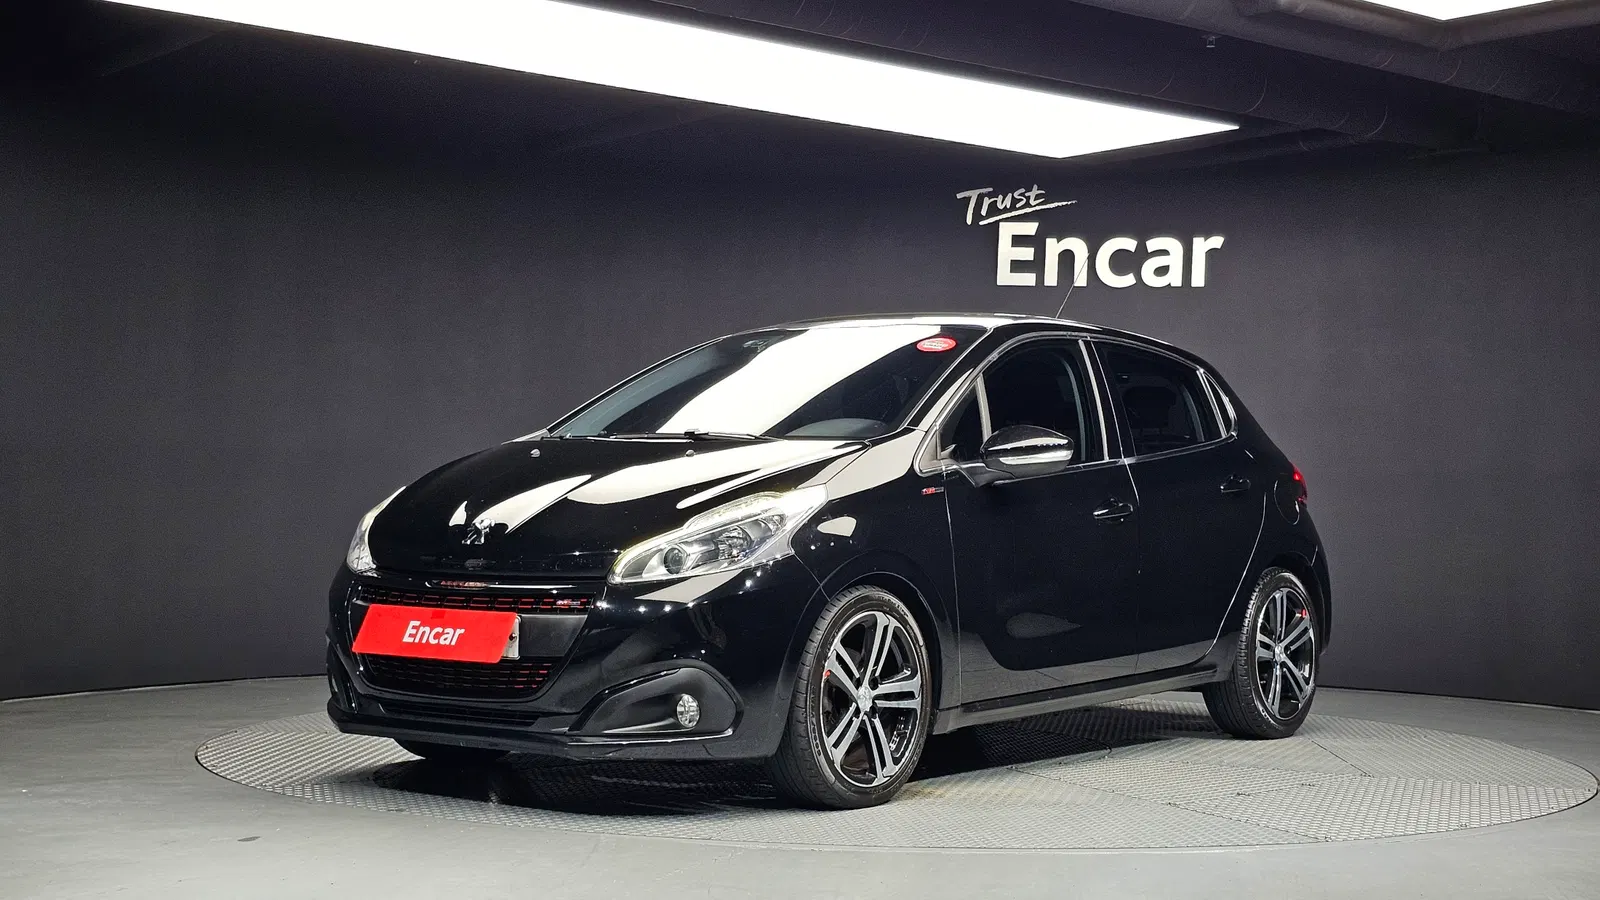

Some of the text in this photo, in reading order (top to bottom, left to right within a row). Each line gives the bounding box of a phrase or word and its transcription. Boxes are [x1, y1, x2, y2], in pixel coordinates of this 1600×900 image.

[956, 183, 1046, 226] Trust
[996, 221, 1226, 288] Encar
[402, 620, 466, 647] Encar
